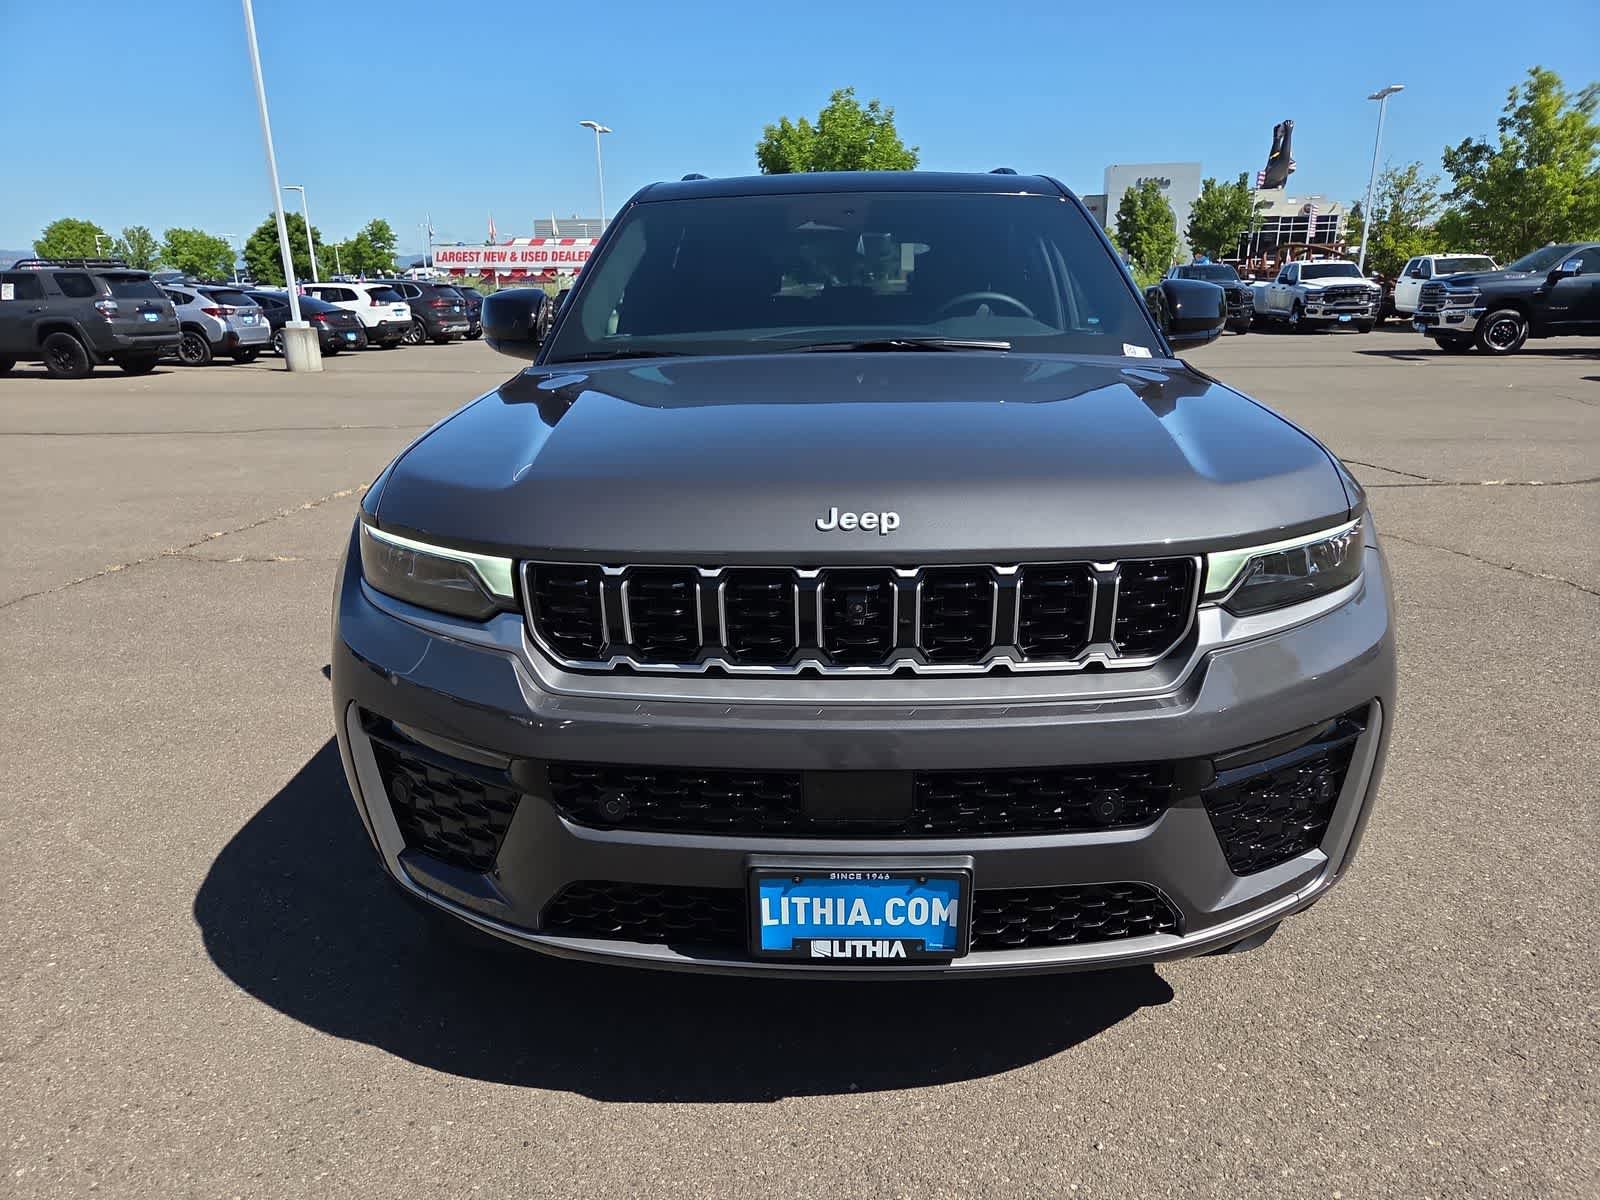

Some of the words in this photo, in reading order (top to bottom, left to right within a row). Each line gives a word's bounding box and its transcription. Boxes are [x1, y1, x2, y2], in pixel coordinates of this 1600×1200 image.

[436, 251, 481, 263] LARGEST
[483, 251, 507, 262] NEW
[509, 251, 519, 262] &
[521, 251, 548, 262] USED
[815, 507, 900, 536] Jeep
[829, 872, 862, 880] SINCE
[866, 872, 891, 880] 1946
[761, 896, 959, 928] LITHIA.COM
[832, 939, 907, 959] LITHIA
